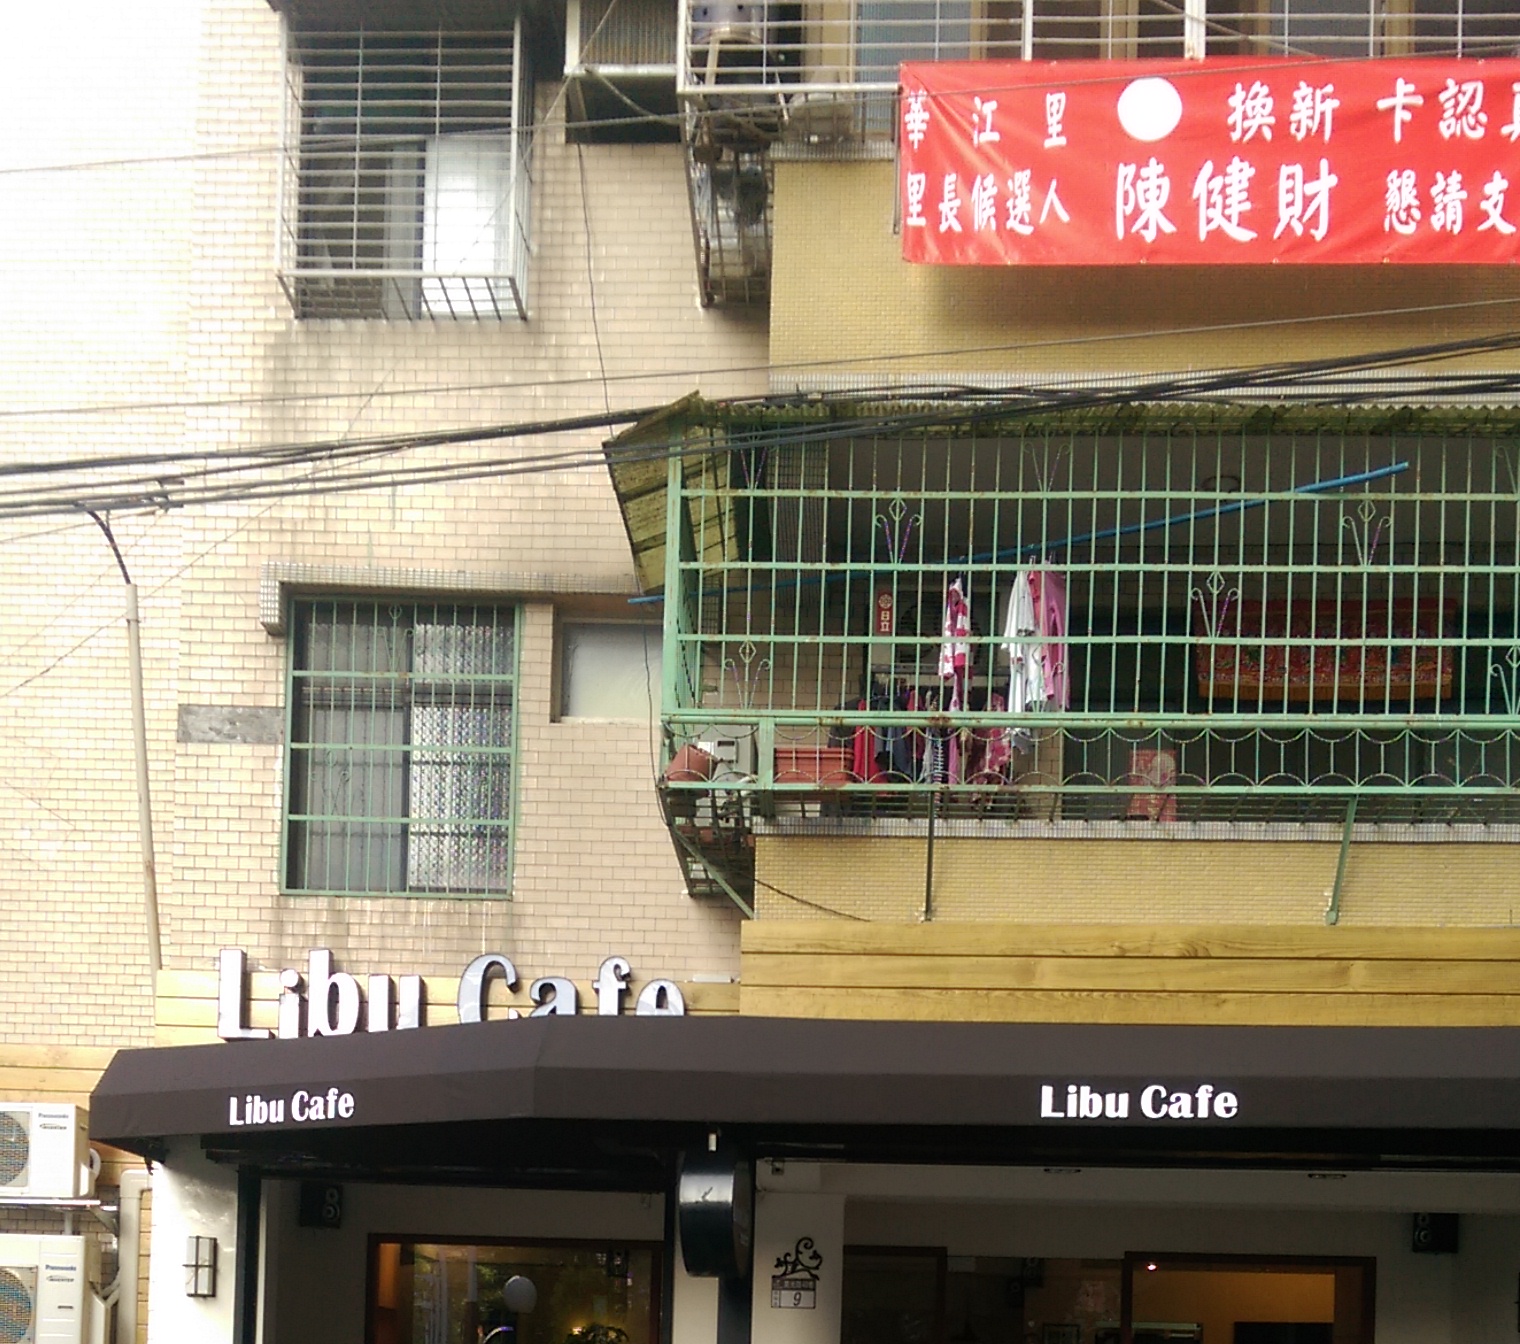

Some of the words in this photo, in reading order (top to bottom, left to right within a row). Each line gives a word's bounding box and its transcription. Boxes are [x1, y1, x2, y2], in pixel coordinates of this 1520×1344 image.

[904, 89, 1067, 151] 華江里
[1228, 81, 1339, 142] 換新
[906, 169, 1070, 235] 里長候選人
[1116, 156, 1338, 243] 陳健財
[1384, 168, 1517, 236] 懇請支
[218, 948, 422, 1040] Libu
[457, 953, 685, 1023] Cafe
[229, 1093, 285, 1126] Libu
[291, 1087, 355, 1122] Cafe
[1041, 1085, 1129, 1118] Libu
[1140, 1085, 1238, 1118] Cafe
[793, 1291, 802, 1306] 9
